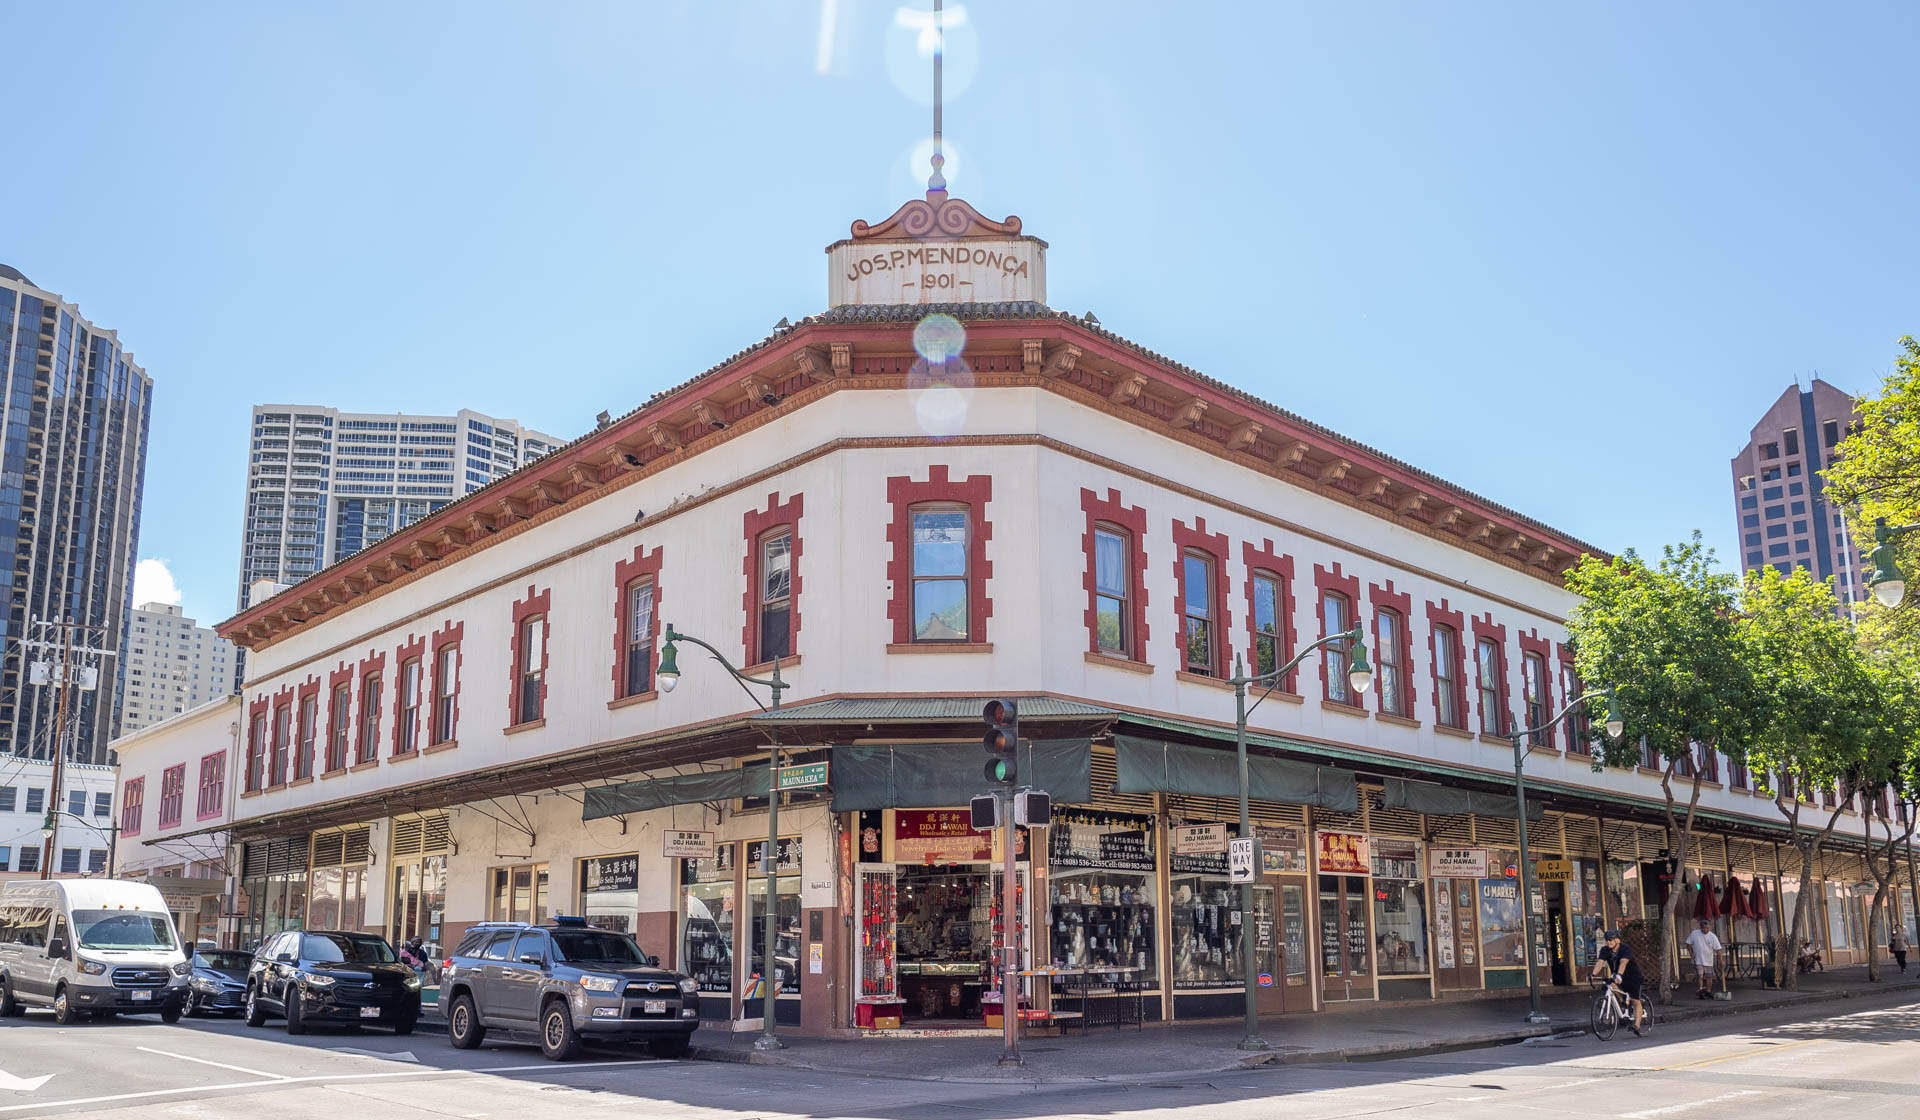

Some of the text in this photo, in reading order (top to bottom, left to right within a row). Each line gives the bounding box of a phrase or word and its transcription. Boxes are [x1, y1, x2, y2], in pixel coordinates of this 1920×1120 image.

[908, 248, 1027, 278] MENDONÇA
[782, 774, 818, 786] MAUNAKEA
[1232, 842, 1251, 853] ONE
[1232, 855, 1251, 865] WAY
[1505, 867, 1518, 876] ATM
[1538, 871, 1570, 879] MARKET
[615, 875, 633, 885] Jewelry
[1483, 885, 1516, 899] CJ MARKET
